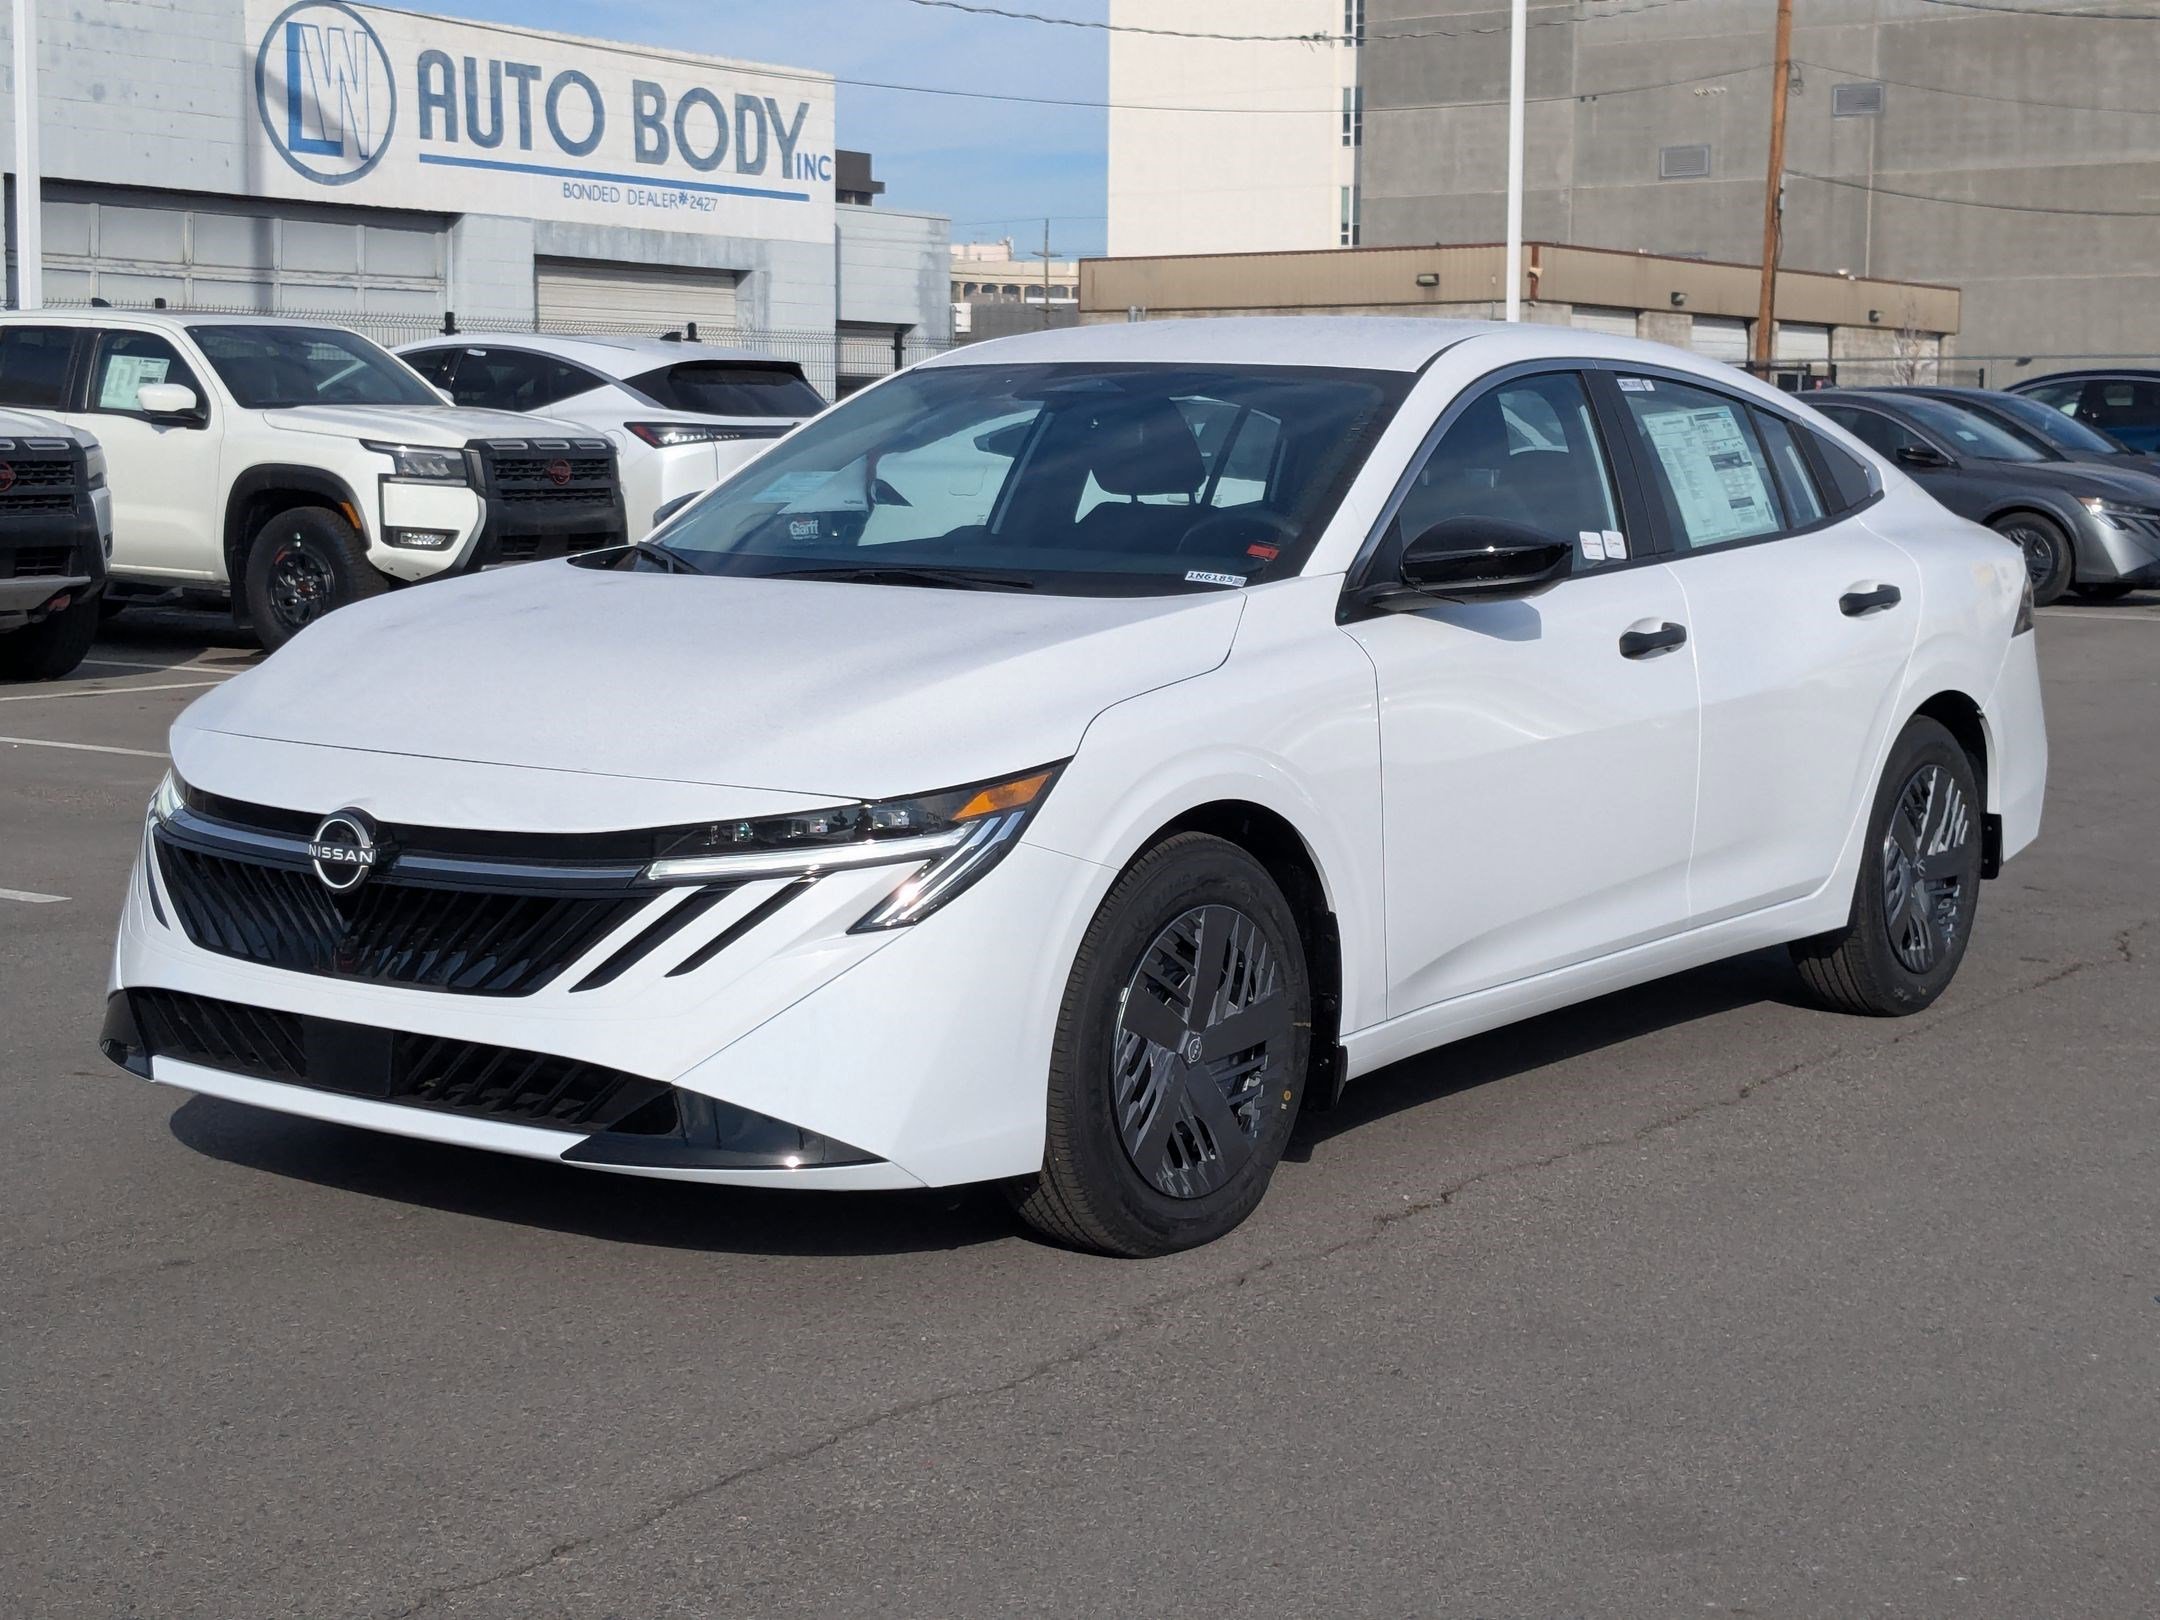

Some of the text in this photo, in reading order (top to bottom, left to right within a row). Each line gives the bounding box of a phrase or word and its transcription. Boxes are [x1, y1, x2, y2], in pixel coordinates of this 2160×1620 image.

[417, 49, 832, 181] AUTO BODY INC
[562, 182, 621, 204] BONDED
[308, 843, 373, 863] NISSAN
